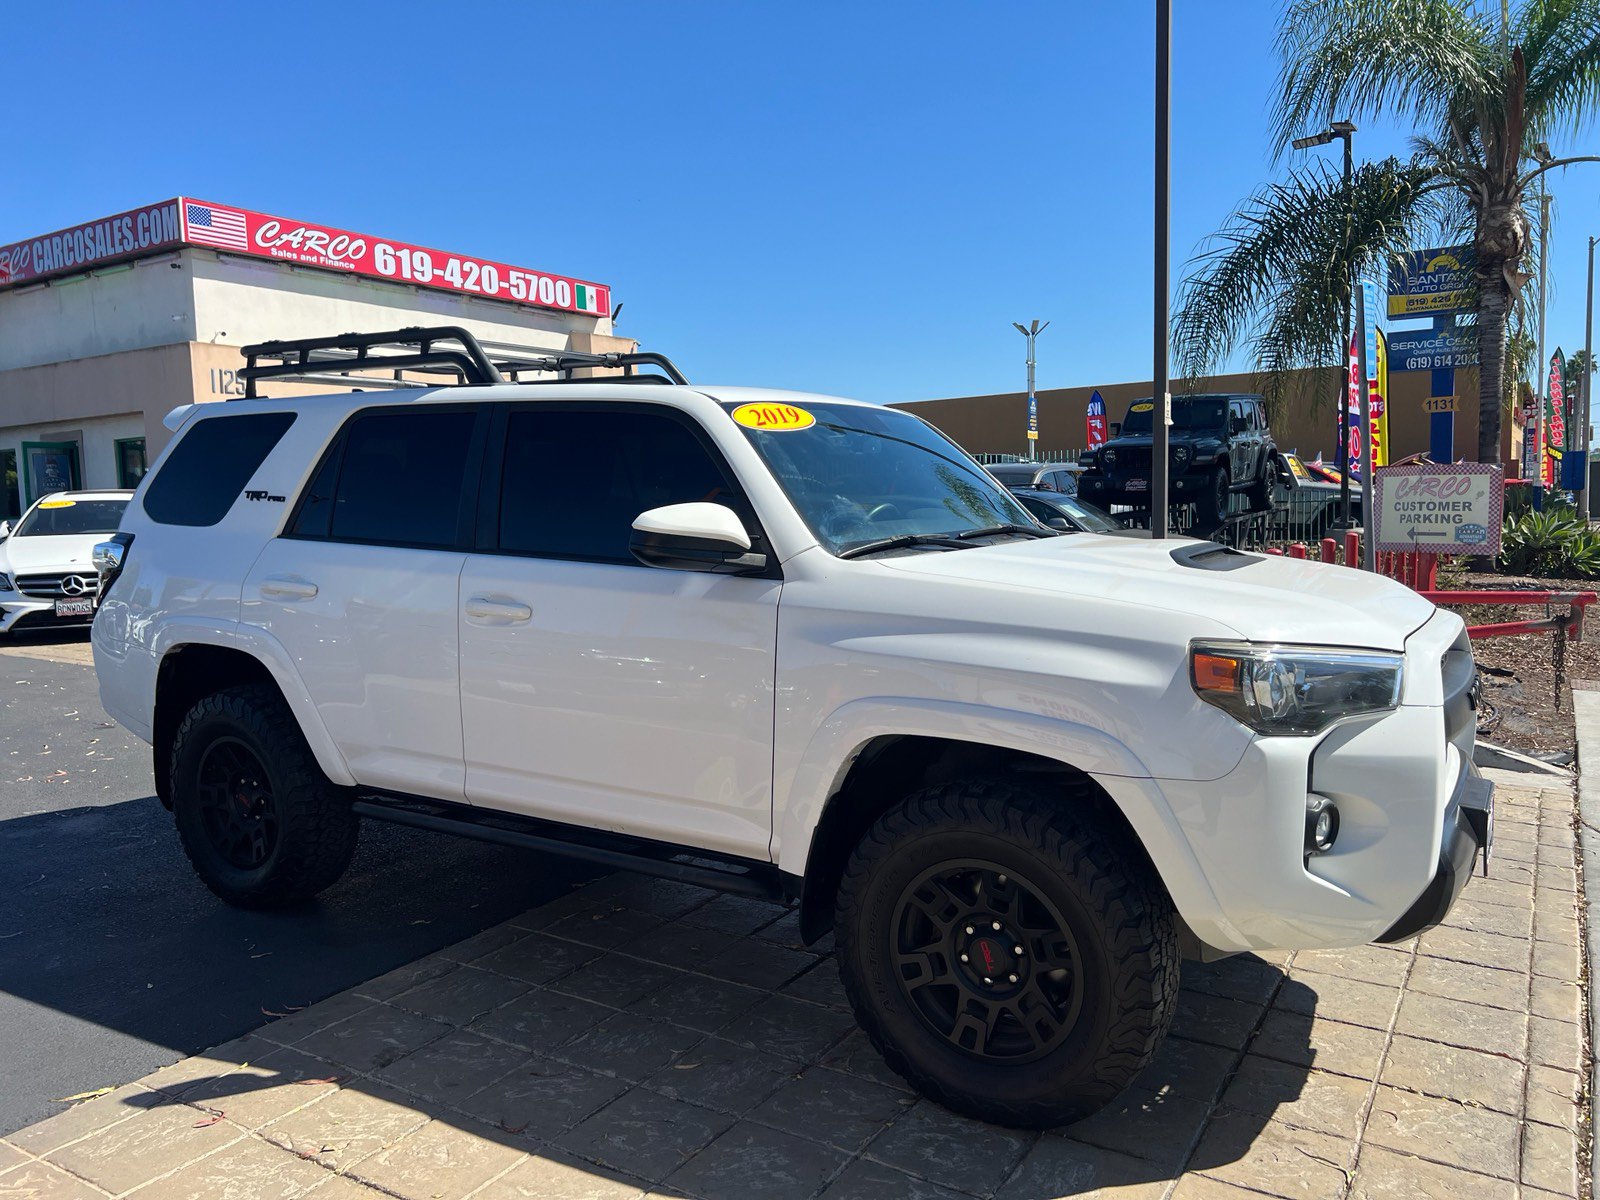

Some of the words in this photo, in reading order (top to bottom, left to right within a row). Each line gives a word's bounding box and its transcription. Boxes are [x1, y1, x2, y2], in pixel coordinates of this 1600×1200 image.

[32, 204, 179, 274] CARCOSALES.COM
[254, 220, 367, 261] CARCO
[270, 247, 298, 259] Sales
[300, 254, 318, 263] and
[319, 256, 356, 270] Finance
[373, 243, 571, 308] 619-420-5700
[1410, 285, 1438, 294] AUTO
[1390, 339, 1444, 351] SERVICE
[1406, 356, 1432, 369] (619)
[1434, 354, 1452, 367] 614
[1426, 399, 1454, 411] 1131
[748, 407, 800, 426] 2019
[1395, 476, 1472, 499] CARCO
[244, 490, 268, 501] TRD
[1394, 501, 1472, 512] CUSTOMER
[1400, 513, 1463, 524] PARKING
